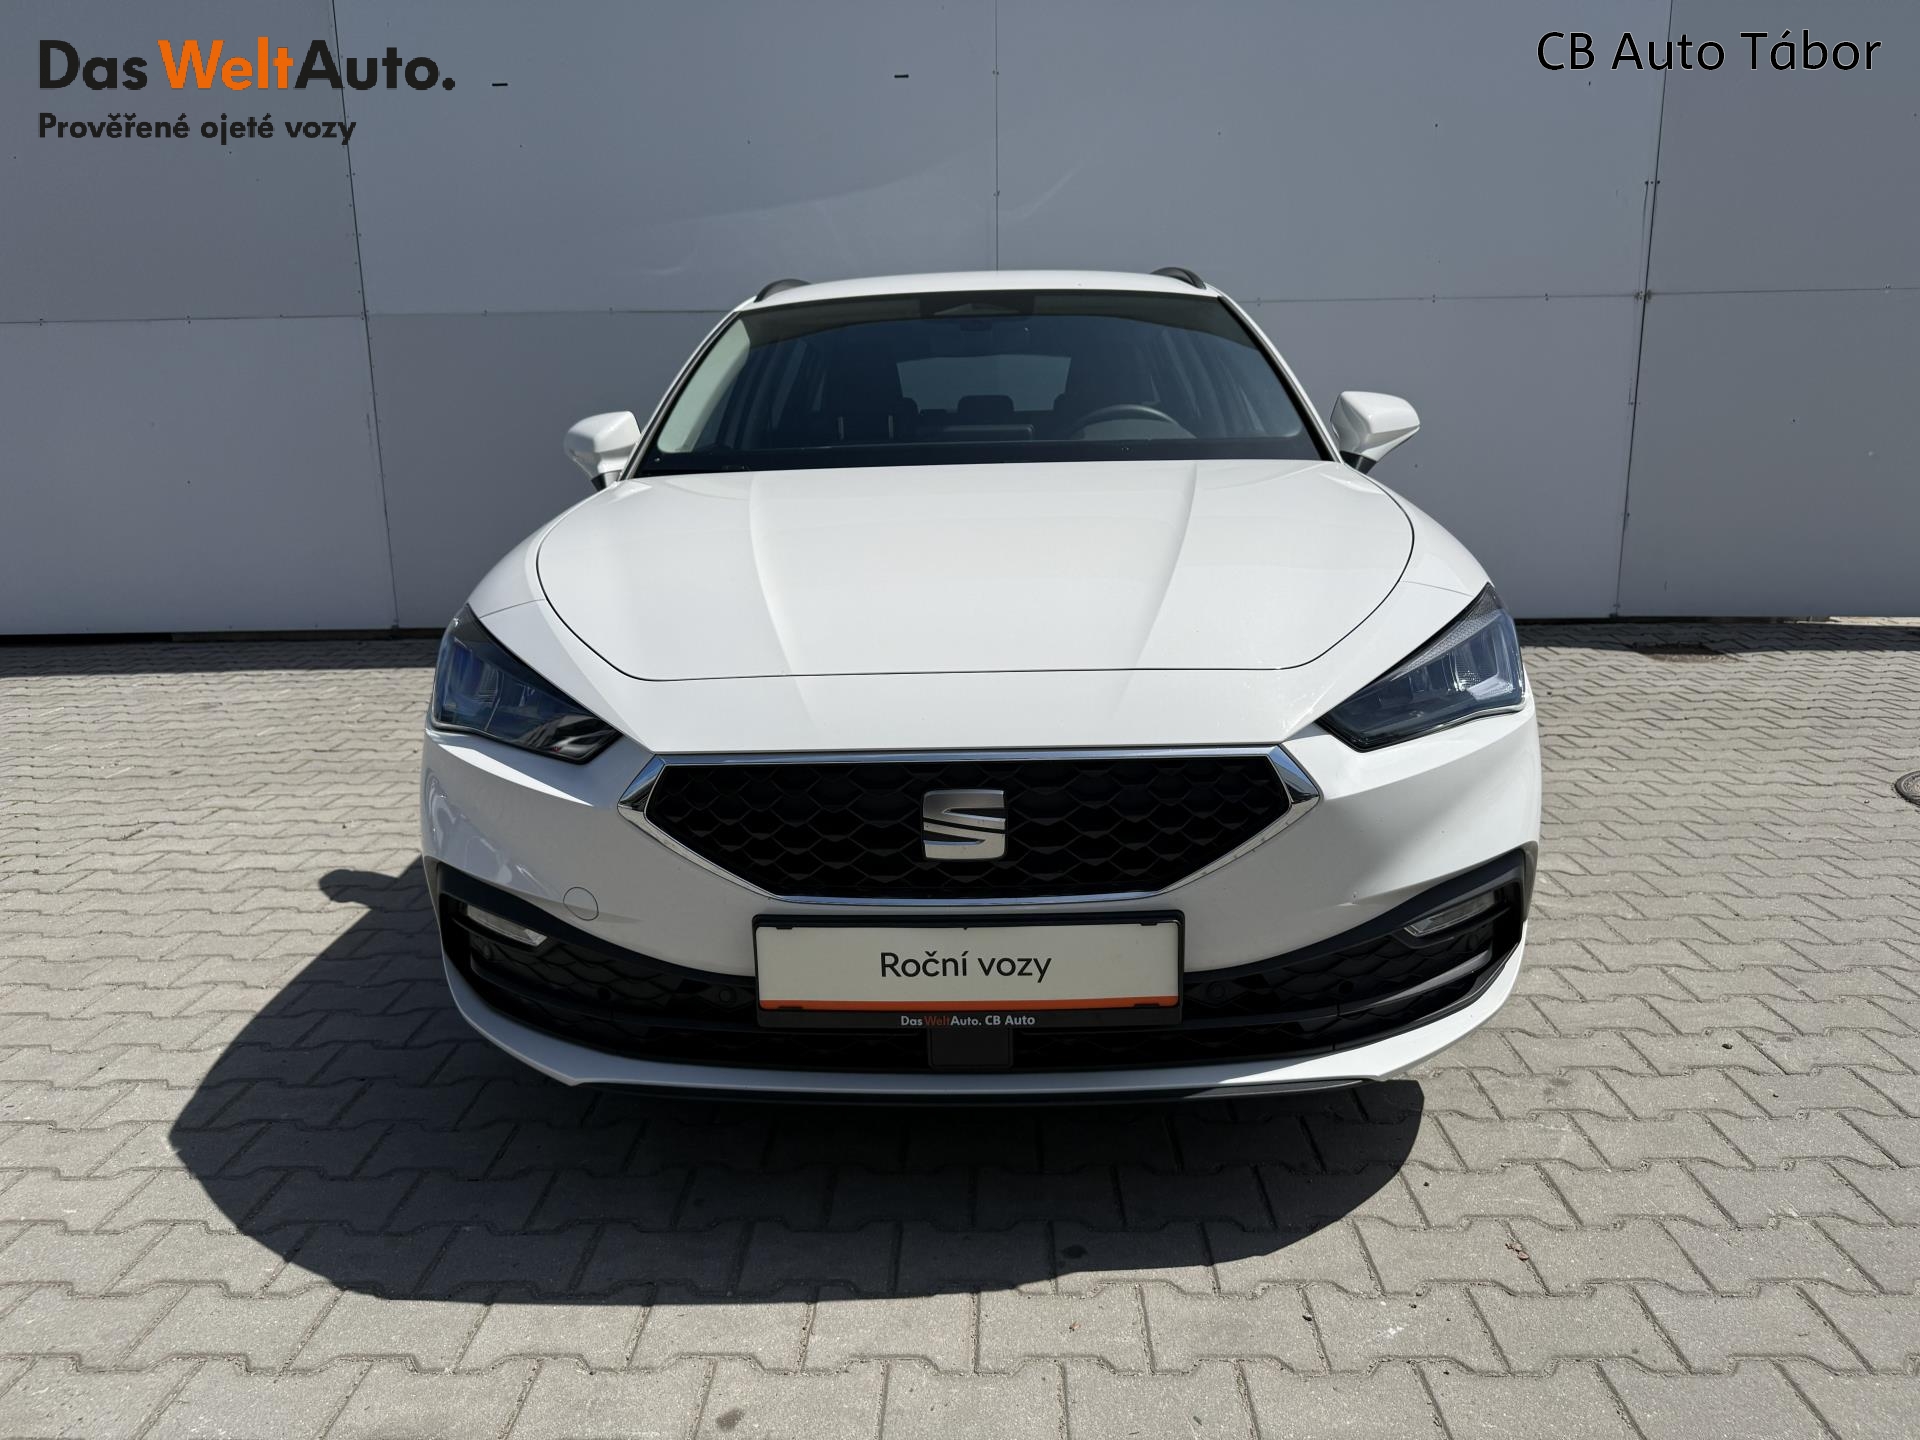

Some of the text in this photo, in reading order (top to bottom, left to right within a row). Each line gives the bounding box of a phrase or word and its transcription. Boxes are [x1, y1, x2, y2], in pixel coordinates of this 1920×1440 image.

[880, 950, 1052, 983] Roční vozy
[900, 1015, 923, 1026] Das
[985, 1015, 1002, 1026] CB
[1004, 1014, 1036, 1026] Auto
